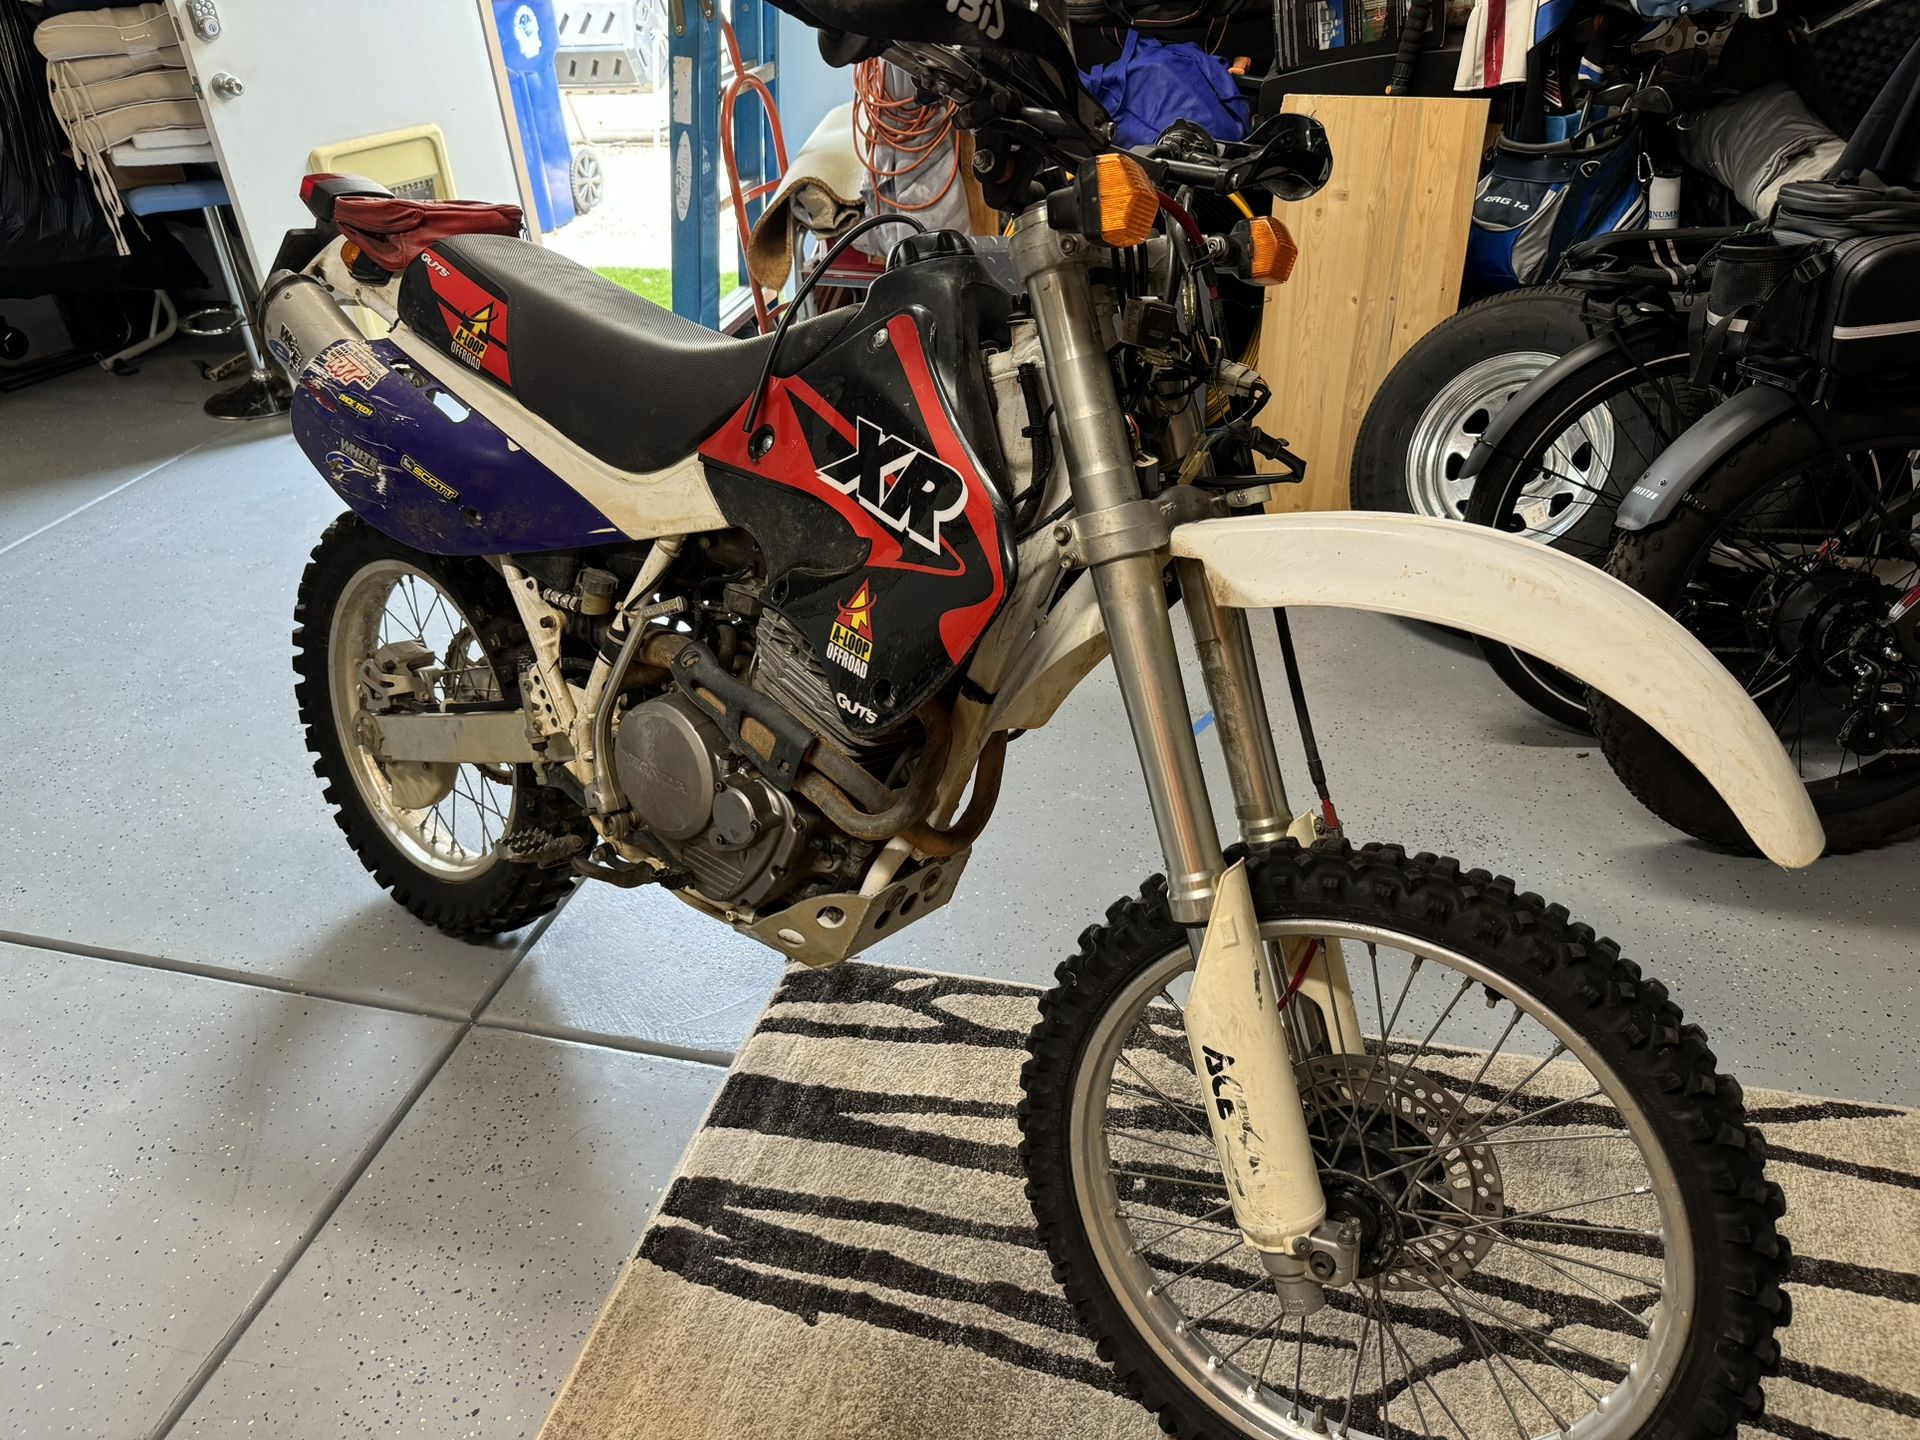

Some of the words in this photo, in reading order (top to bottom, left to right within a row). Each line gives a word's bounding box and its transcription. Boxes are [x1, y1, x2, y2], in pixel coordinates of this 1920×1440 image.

[1514, 200, 1530, 211] 14
[421, 252, 450, 277] GUTS
[451, 341, 481, 371] OFFROAD
[455, 328, 486, 356] A-LOOP
[340, 437, 380, 472] WHITE
[412, 464, 459, 500] SCOTT
[814, 415, 969, 556] XR
[832, 626, 870, 657] A-LOOP
[826, 641, 868, 680] OFFROAD
[836, 692, 878, 724] GUTS
